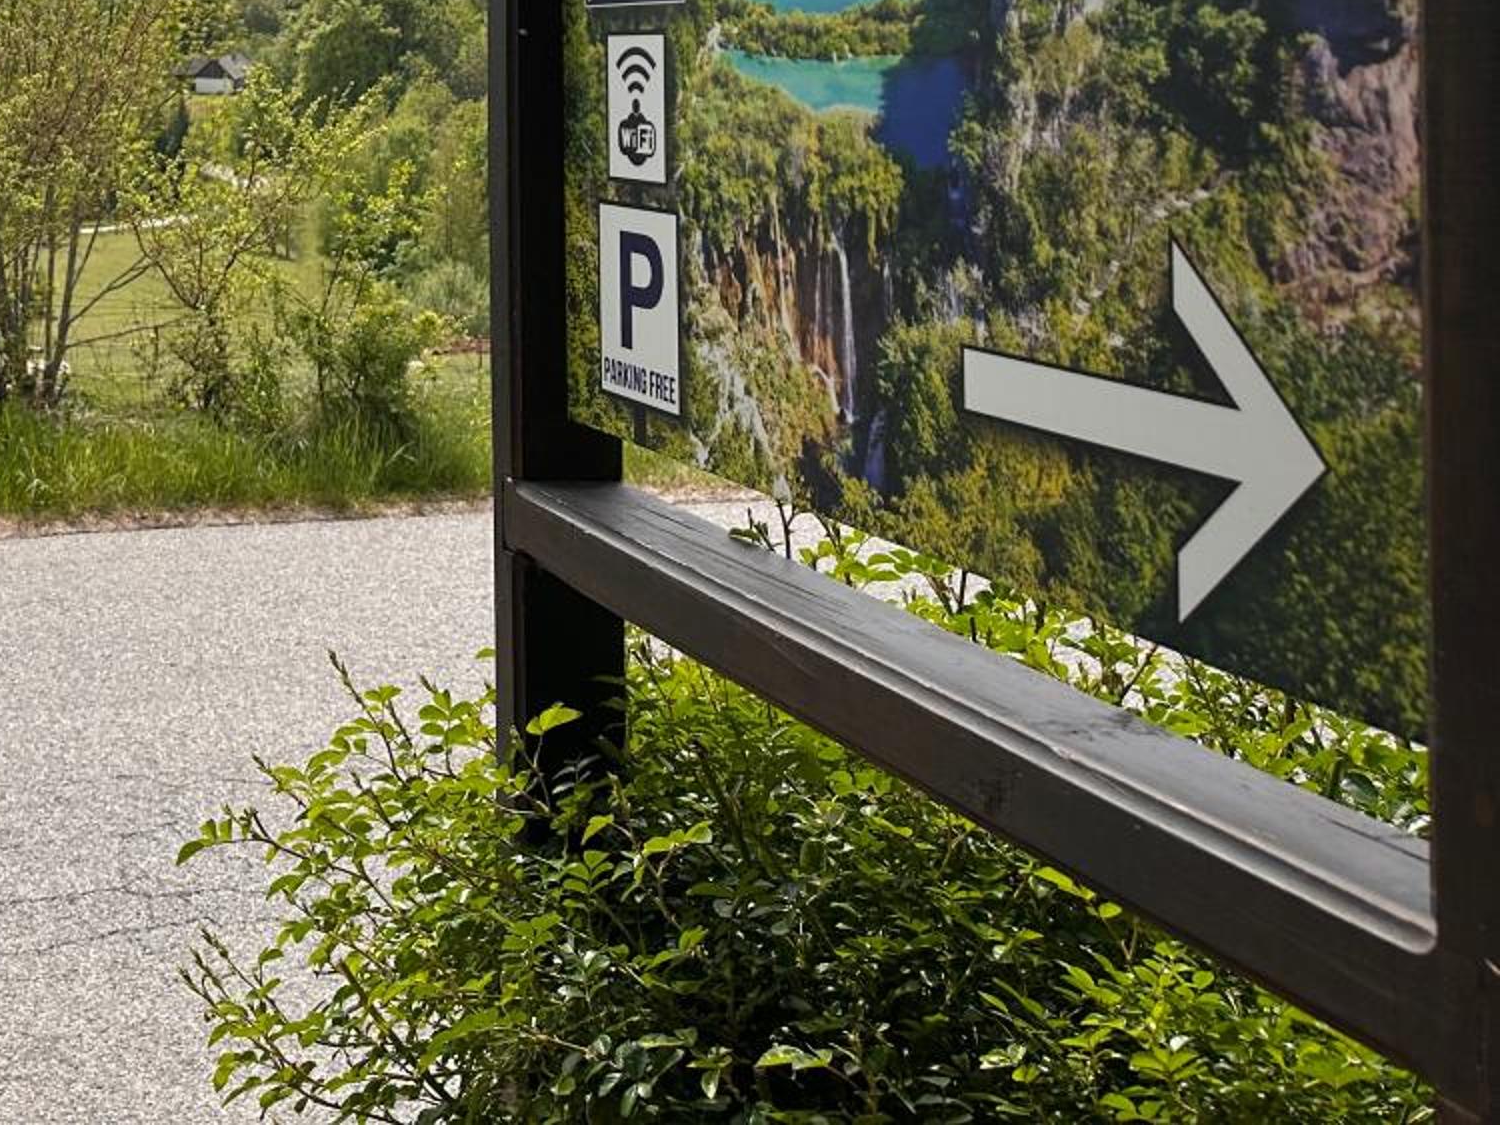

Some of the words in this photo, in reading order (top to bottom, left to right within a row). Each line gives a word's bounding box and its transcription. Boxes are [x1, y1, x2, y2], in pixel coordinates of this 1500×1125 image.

[620, 230, 664, 350] P
[604, 357, 647, 395] PARKING
[650, 371, 676, 405] FREE
